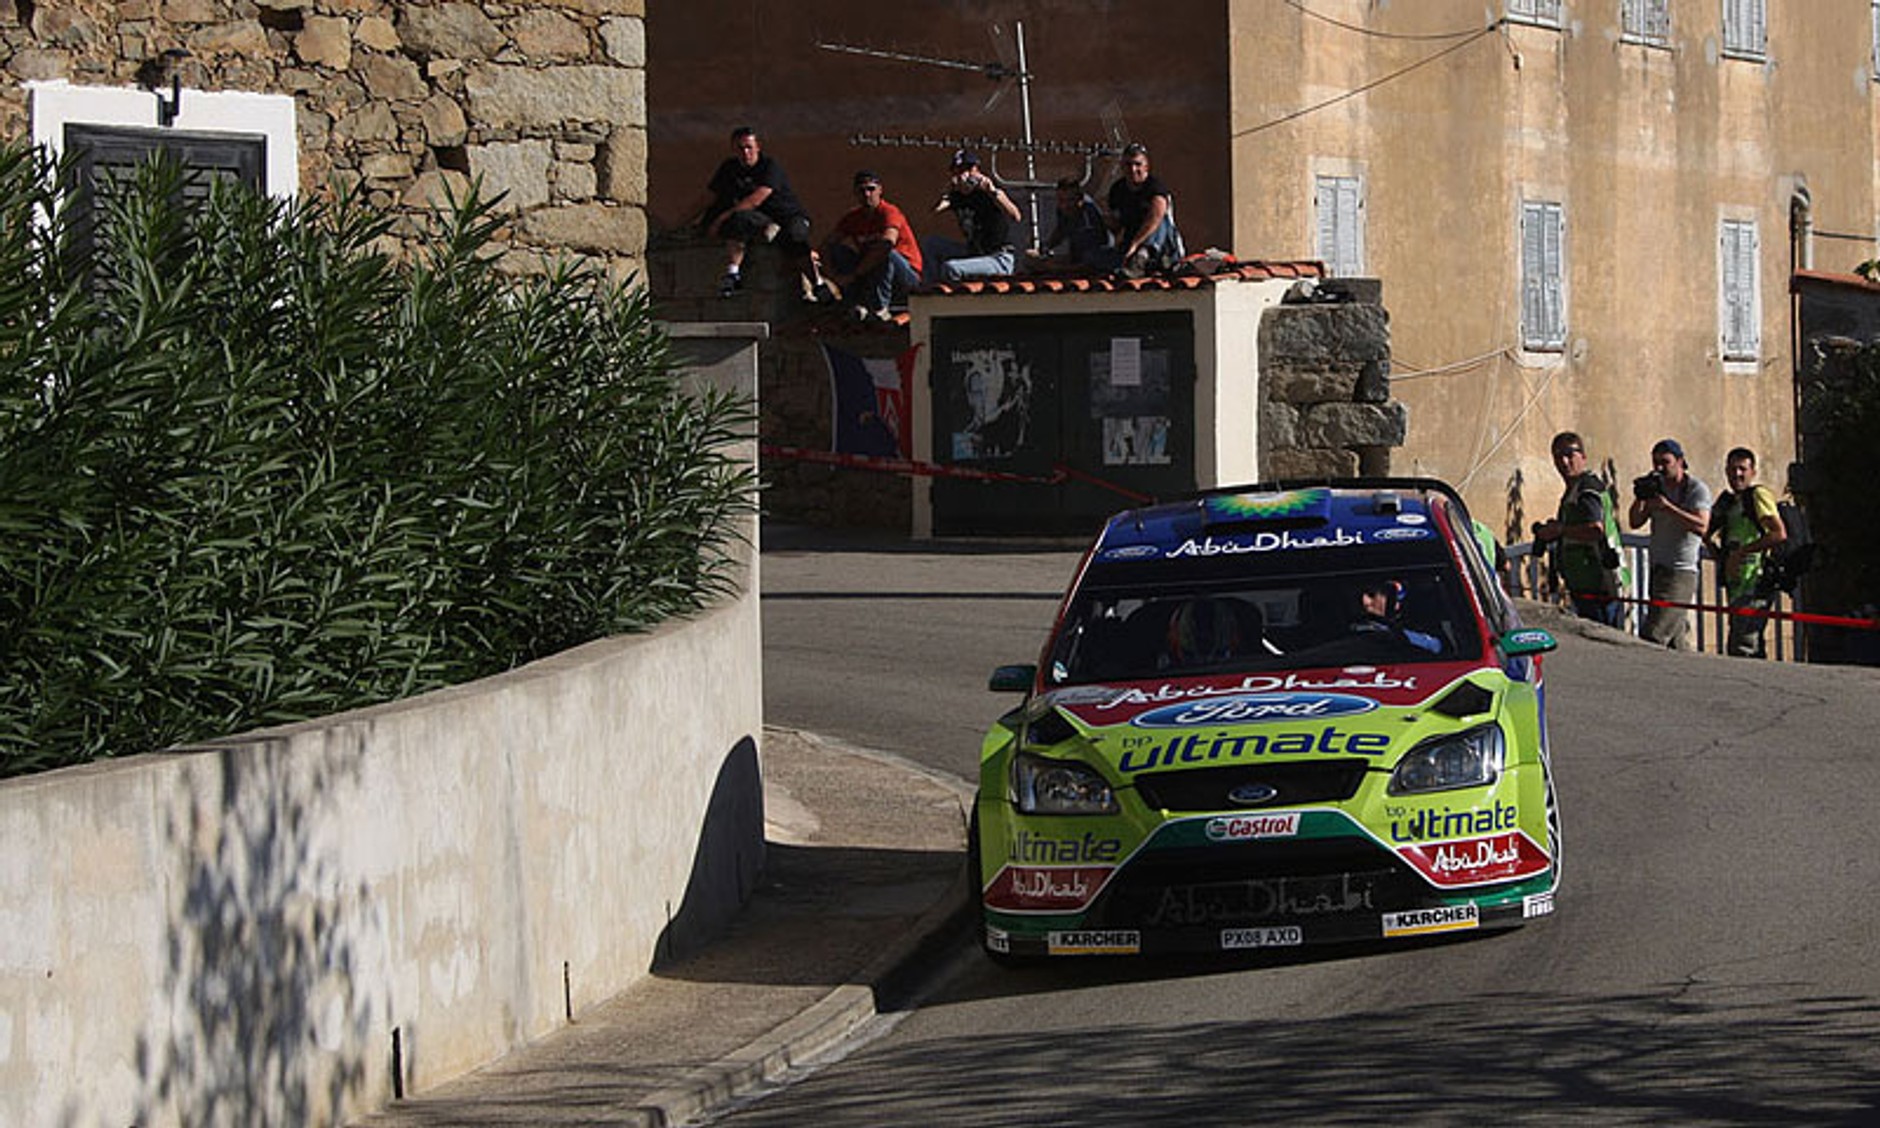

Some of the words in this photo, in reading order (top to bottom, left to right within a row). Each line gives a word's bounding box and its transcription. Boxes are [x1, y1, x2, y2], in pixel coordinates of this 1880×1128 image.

[1175, 696, 1333, 724] Ford
[1119, 727, 1390, 772] ultimate
[1228, 816, 1295, 836] Castrol
[1391, 799, 1517, 842] ultimate
[1224, 930, 1261, 945] PX08
[1266, 928, 1299, 943] AXD
